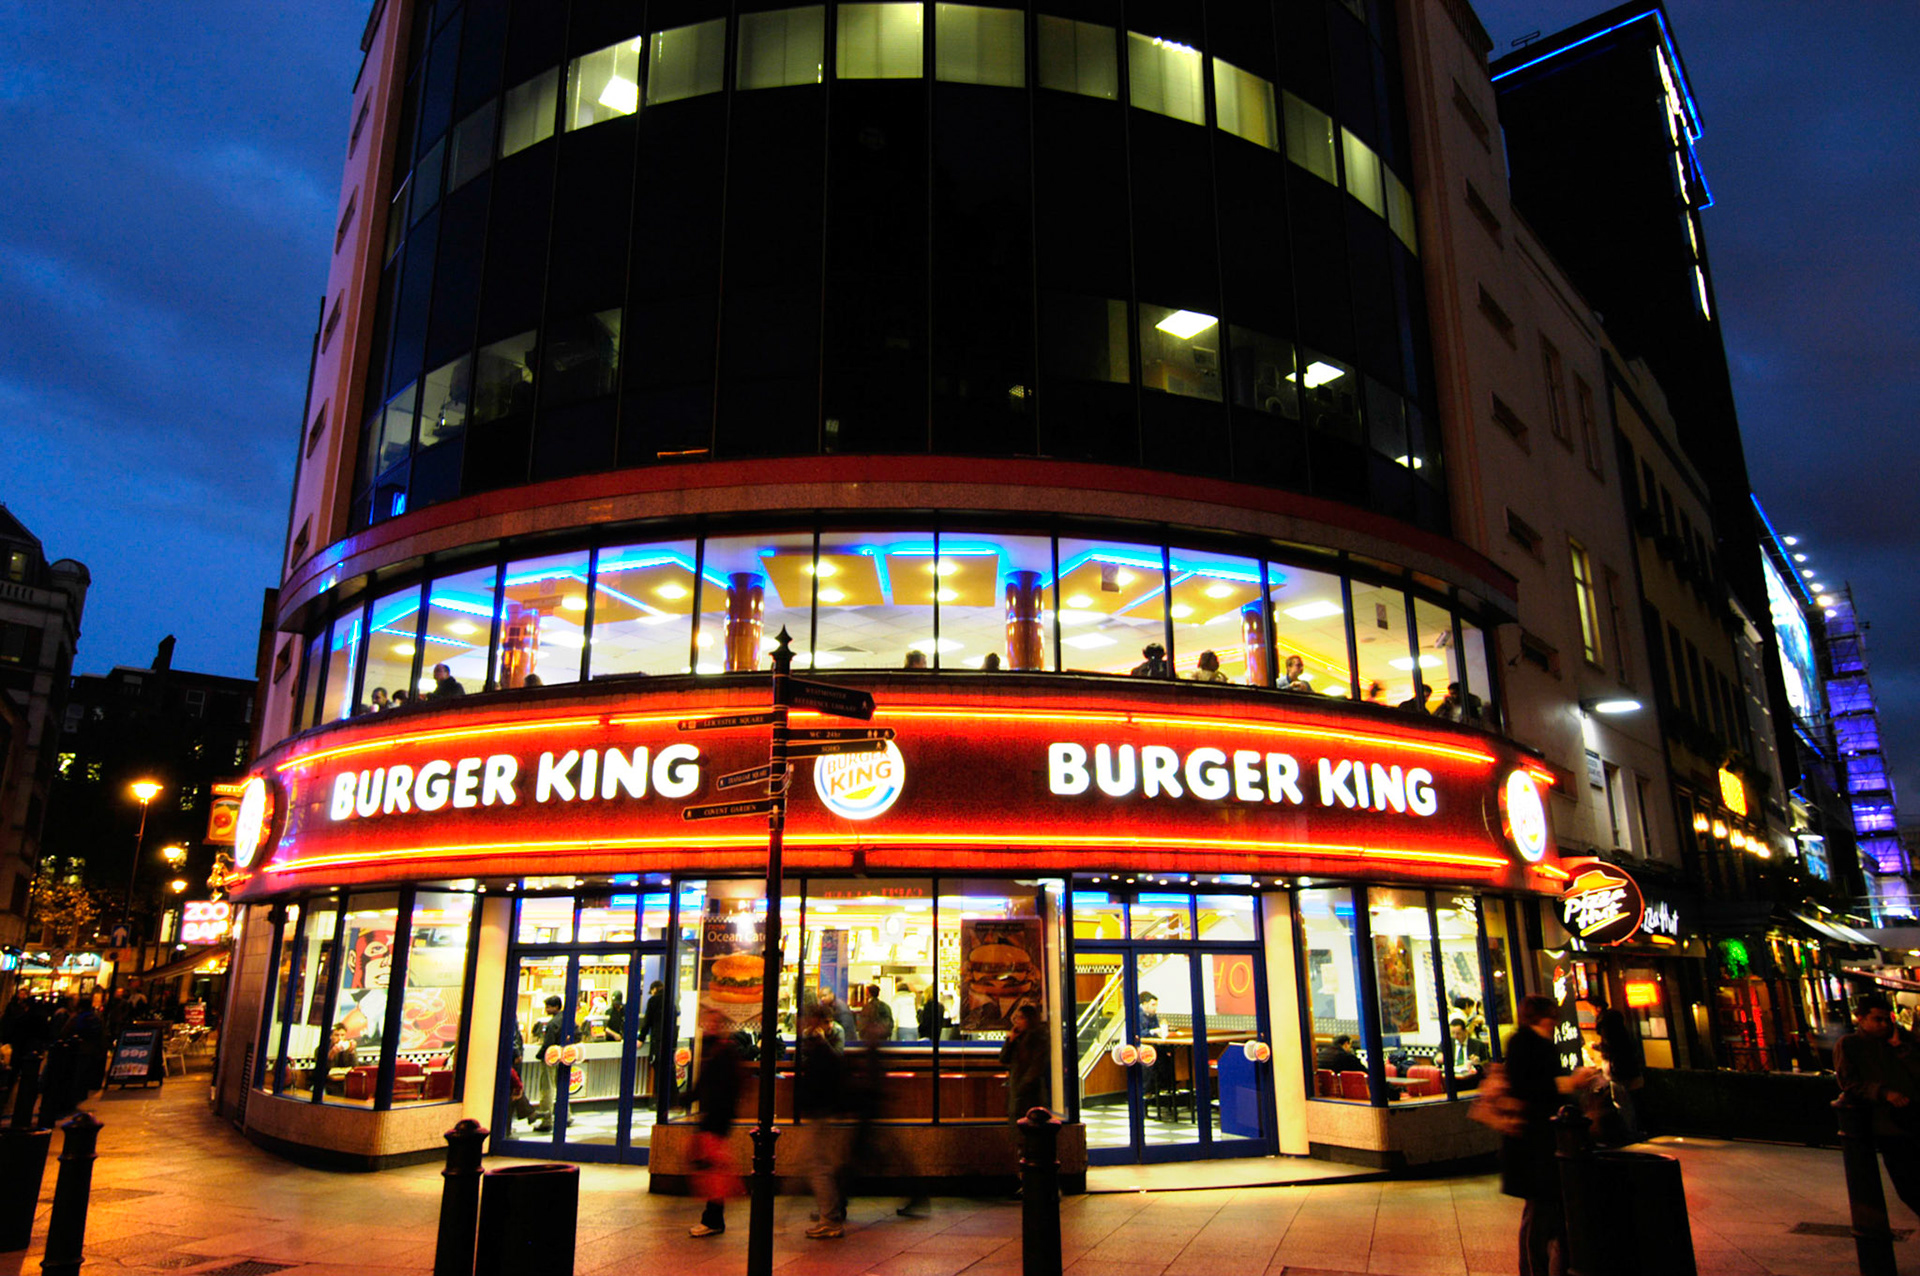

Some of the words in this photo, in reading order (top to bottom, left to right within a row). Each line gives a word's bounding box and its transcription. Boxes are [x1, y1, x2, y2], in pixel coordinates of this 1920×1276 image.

[703, 719, 737, 727] LEICESTER
[739, 716, 764, 724] SQUARE
[330, 754, 518, 821] BURGER
[536, 743, 700, 803] KING
[830, 760, 892, 796] KING
[1048, 742, 1303, 805] BURGER
[1318, 757, 1437, 816] KING
[703, 806, 728, 815] COVENT
[730, 804, 757, 813] GARDEN
[183, 902, 230, 921] ZOO
[1564, 888, 1628, 924] Pizza
[1575, 901, 1624, 930] Hut
[707, 931, 742, 942] Ocean
